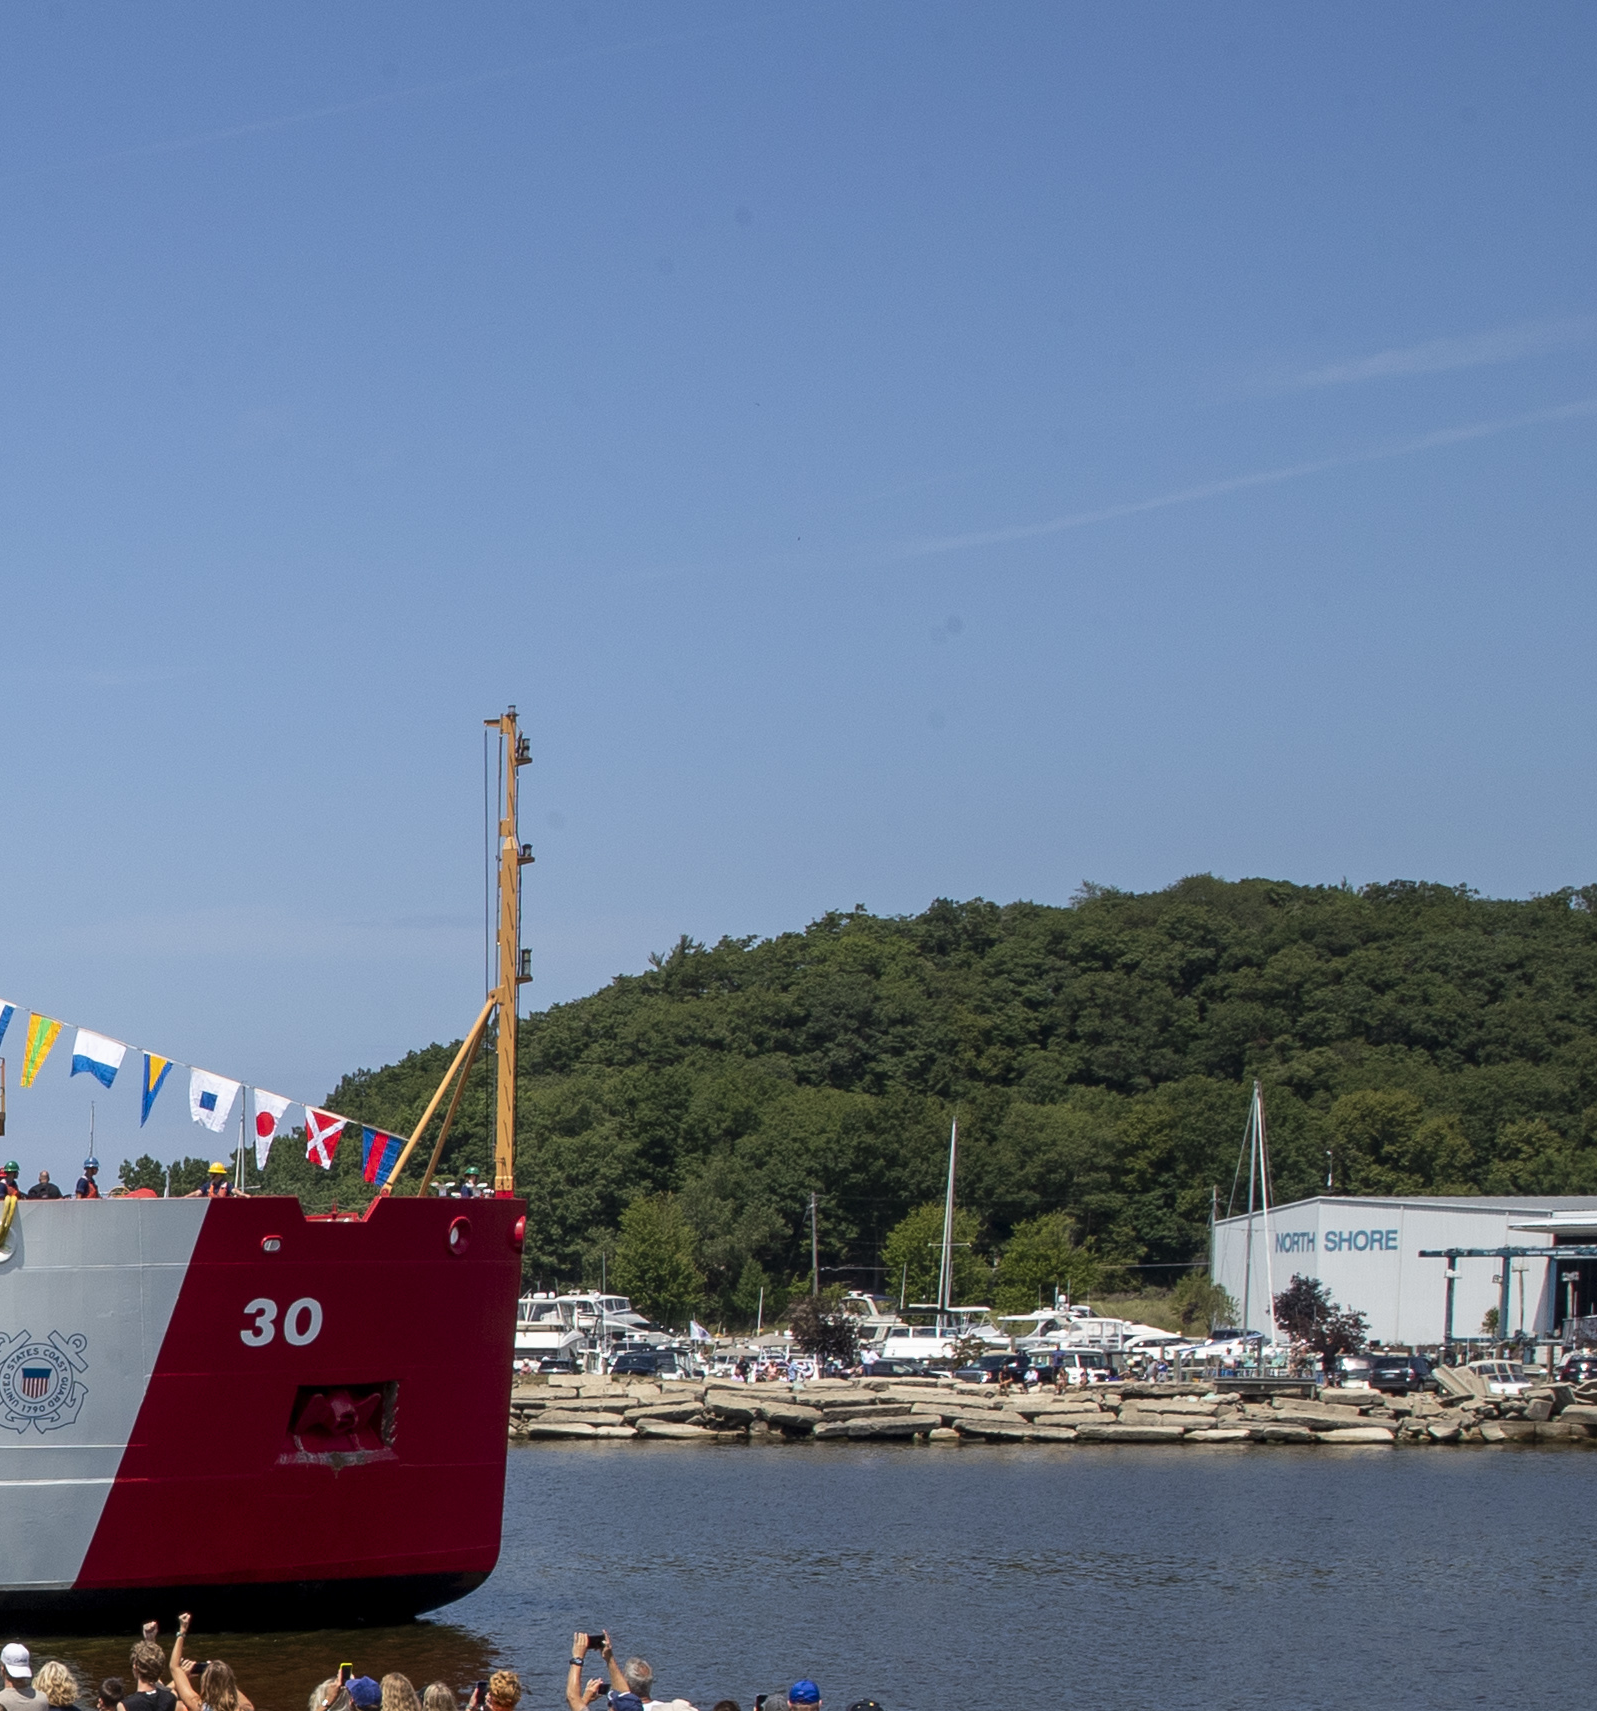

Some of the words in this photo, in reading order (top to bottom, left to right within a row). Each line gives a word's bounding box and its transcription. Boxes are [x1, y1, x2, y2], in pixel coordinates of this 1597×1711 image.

[1275, 1231, 1315, 1253] NORTH
[1324, 1229, 1398, 1252] SHORE
[241, 1298, 322, 1346] 30
[7, 1347, 39, 1371] STATES
[43, 1348, 68, 1373] COAST
[2, 1373, 20, 1408] UNITED
[47, 1376, 69, 1408] GUARD
[21, 1404, 46, 1414] 1790
